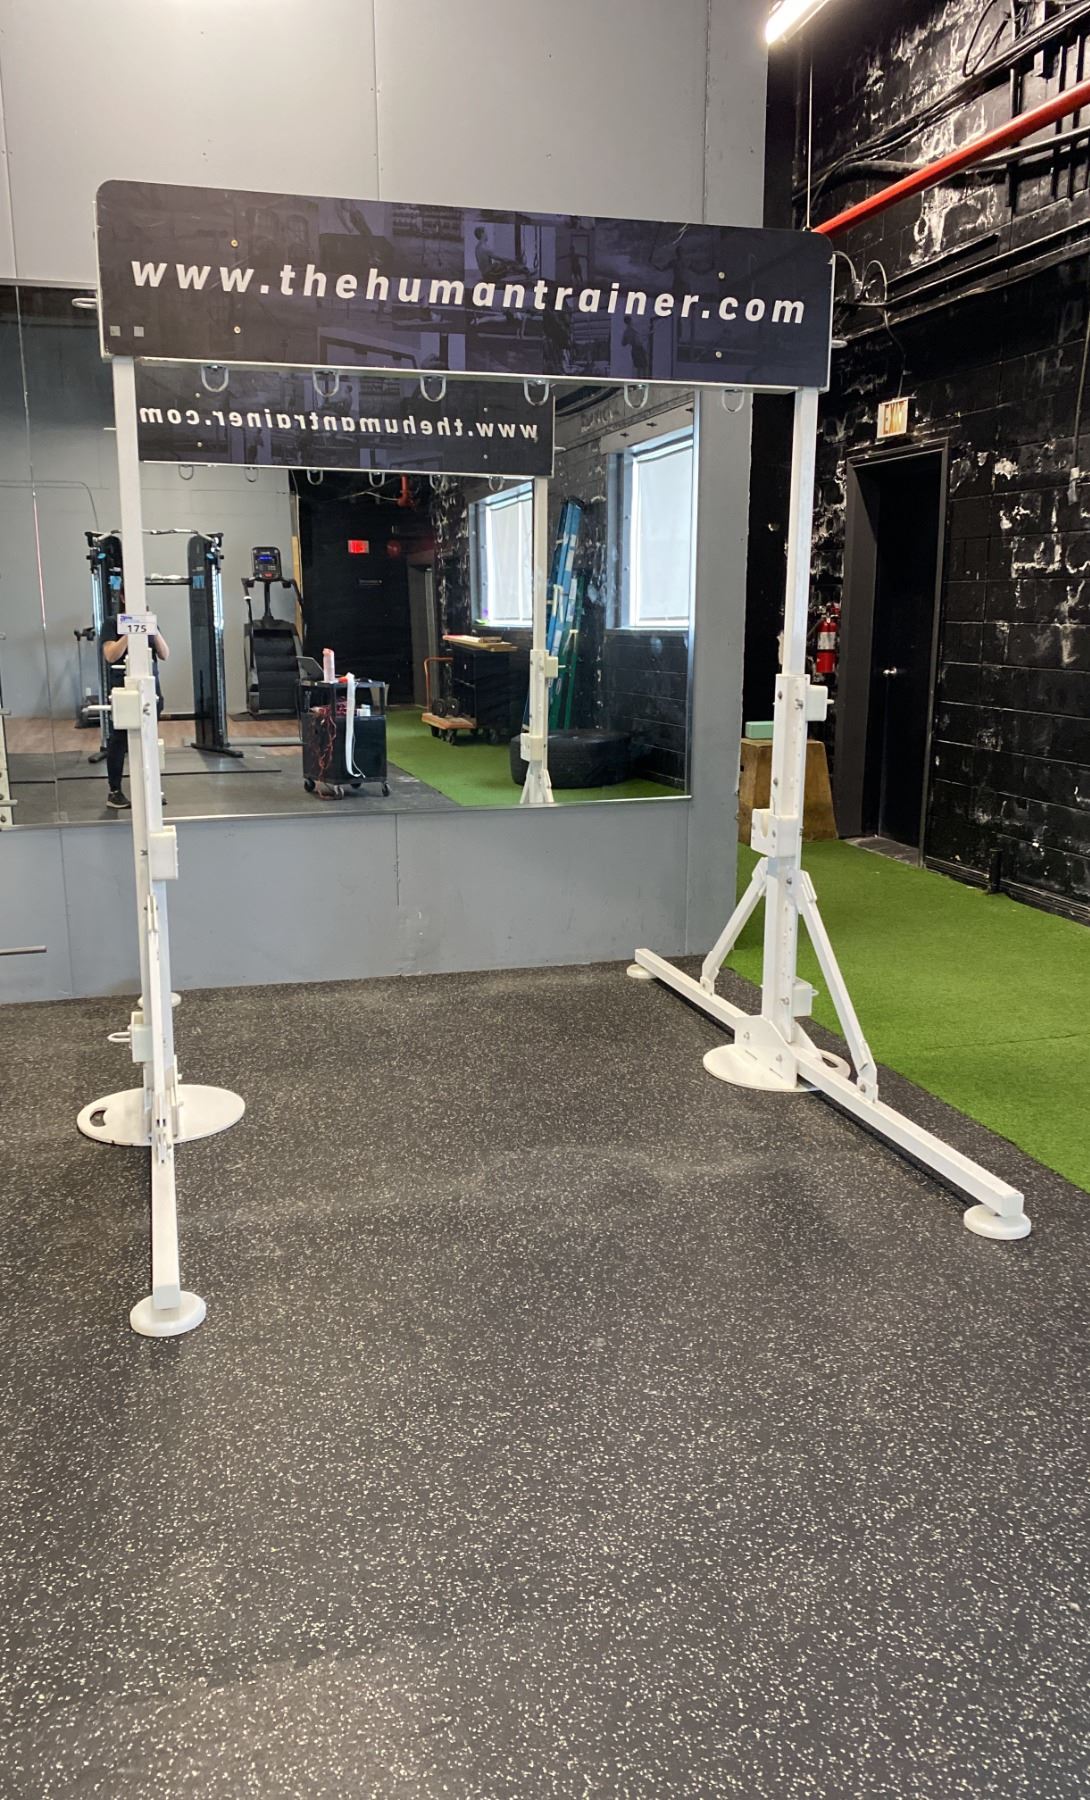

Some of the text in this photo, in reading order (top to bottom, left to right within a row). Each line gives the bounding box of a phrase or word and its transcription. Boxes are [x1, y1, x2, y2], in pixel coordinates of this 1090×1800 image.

[131, 260, 805, 324] www.thehumantrainer.com
[882, 401, 905, 435] EXIT
[127, 624, 147, 633] 175
